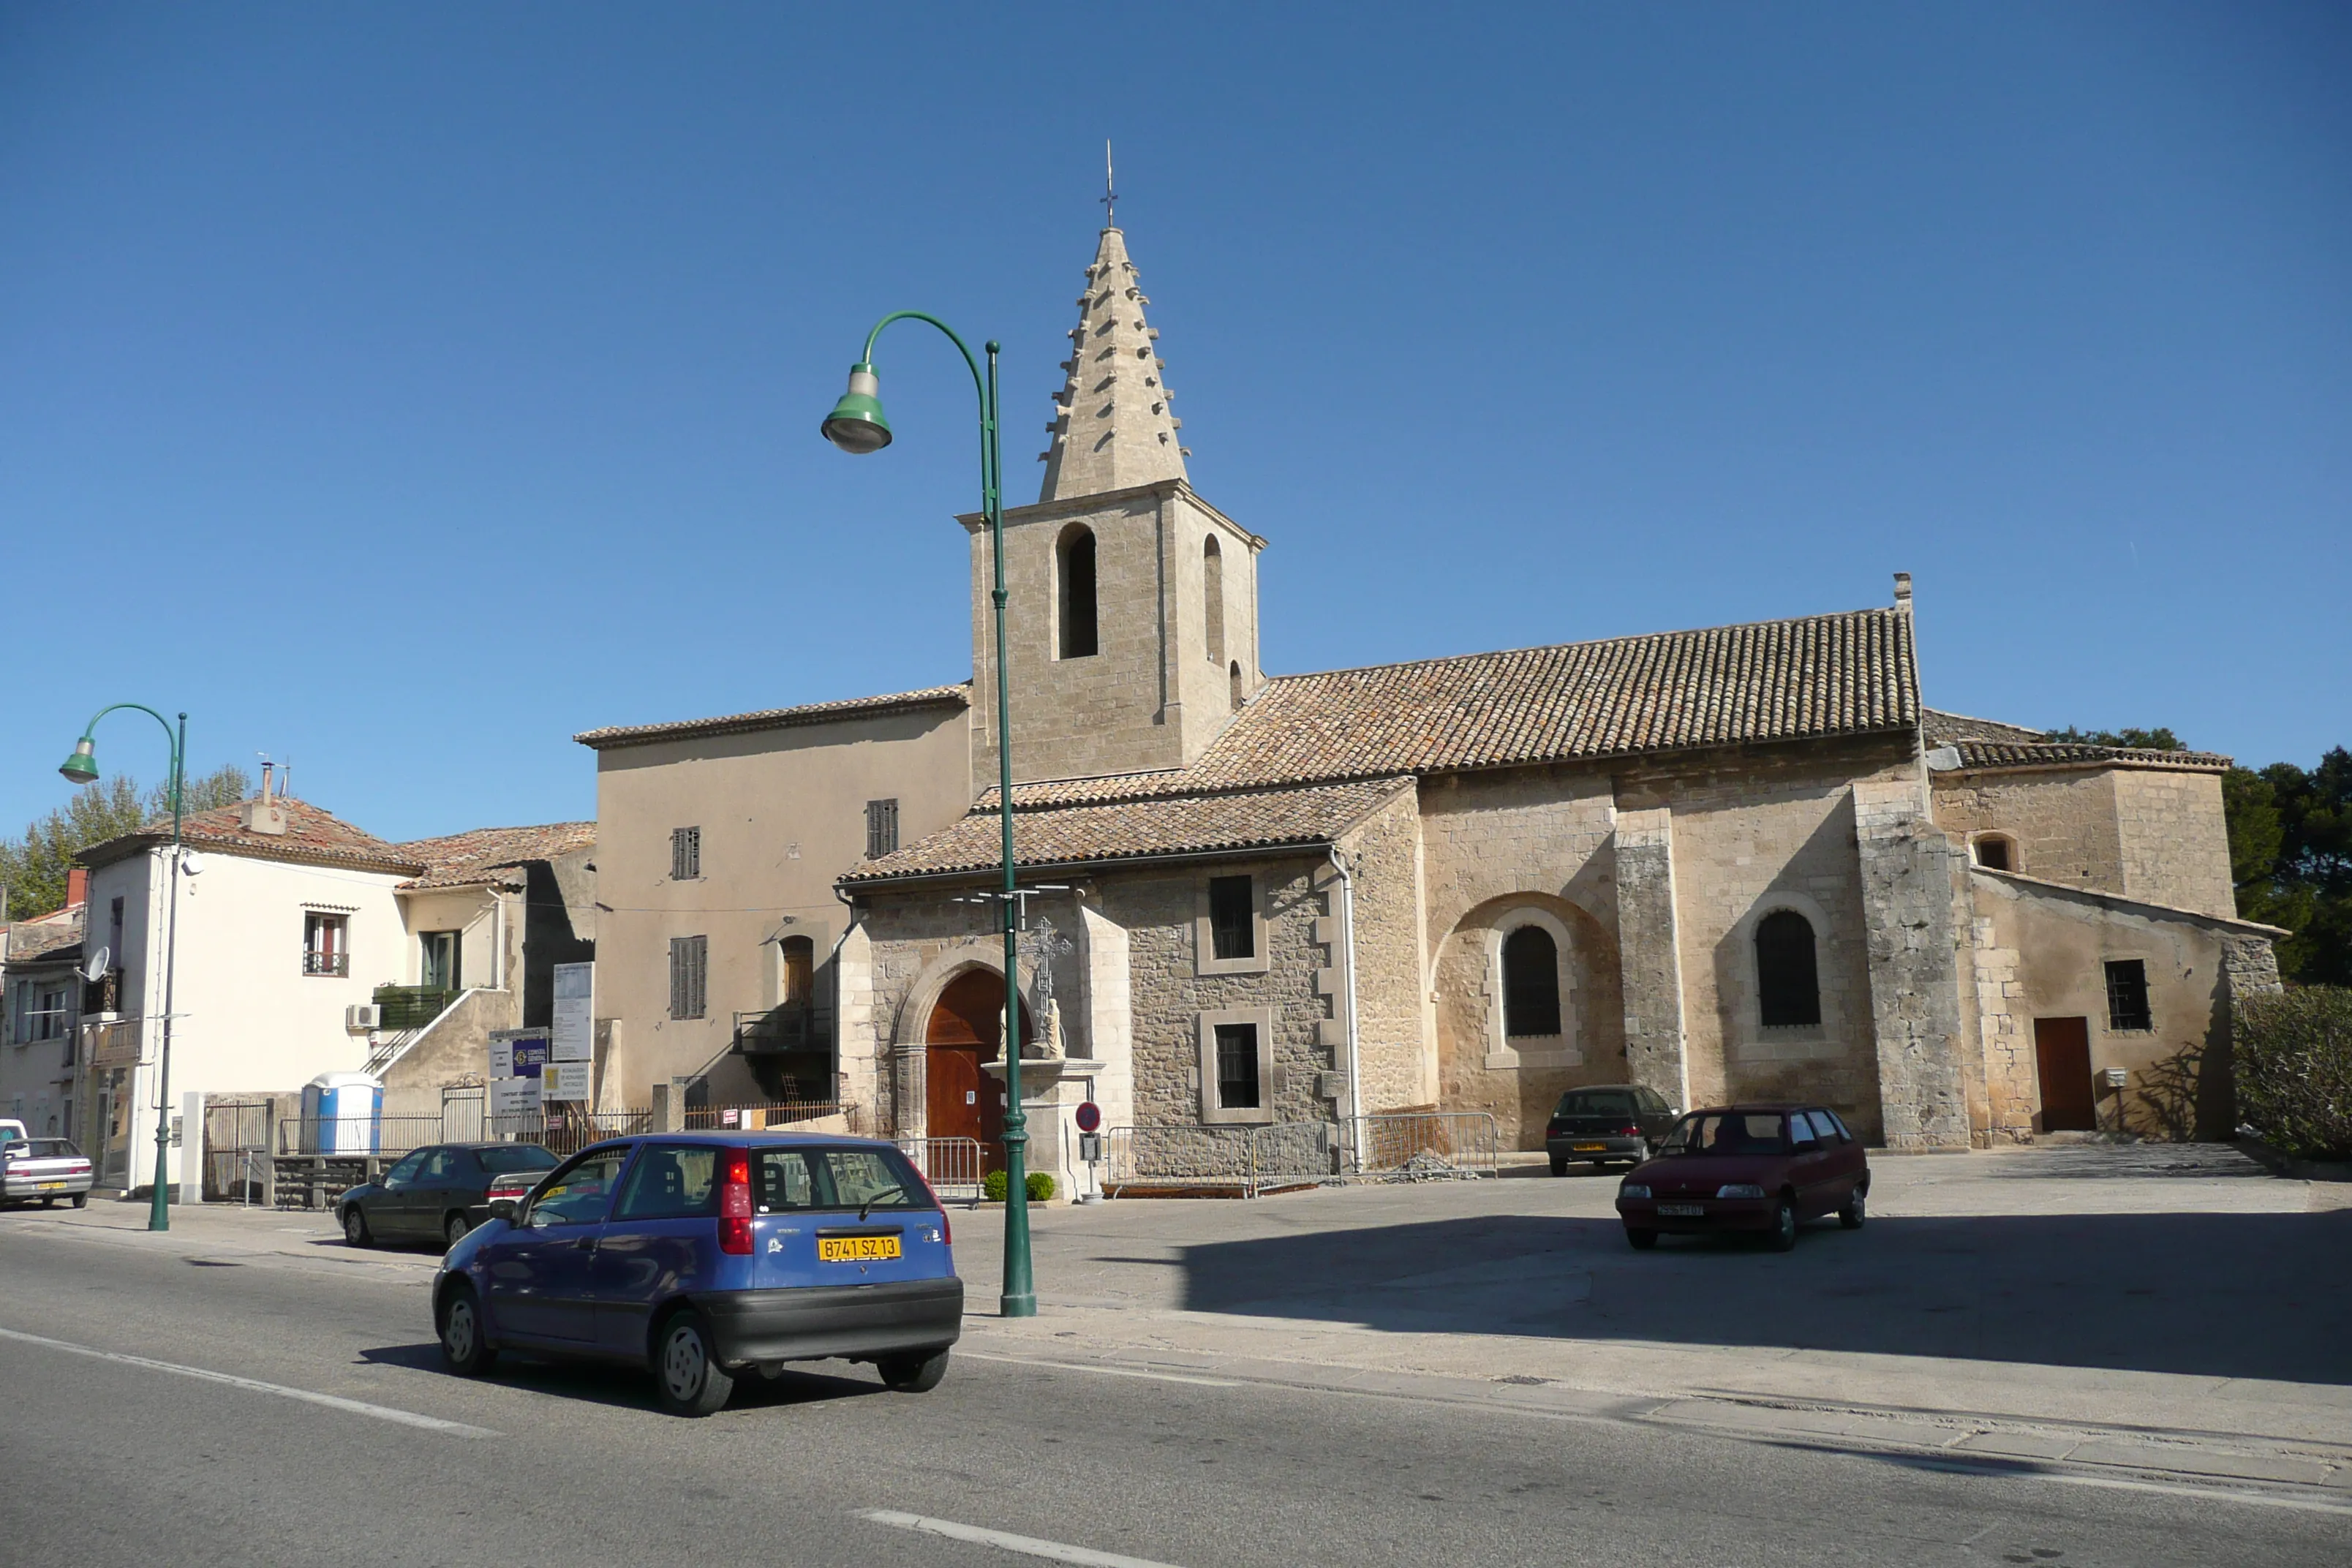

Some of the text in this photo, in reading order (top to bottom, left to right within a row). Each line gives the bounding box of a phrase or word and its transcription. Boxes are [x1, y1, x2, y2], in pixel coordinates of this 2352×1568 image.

[825, 1239, 895, 1257] 8741 SZ 13
